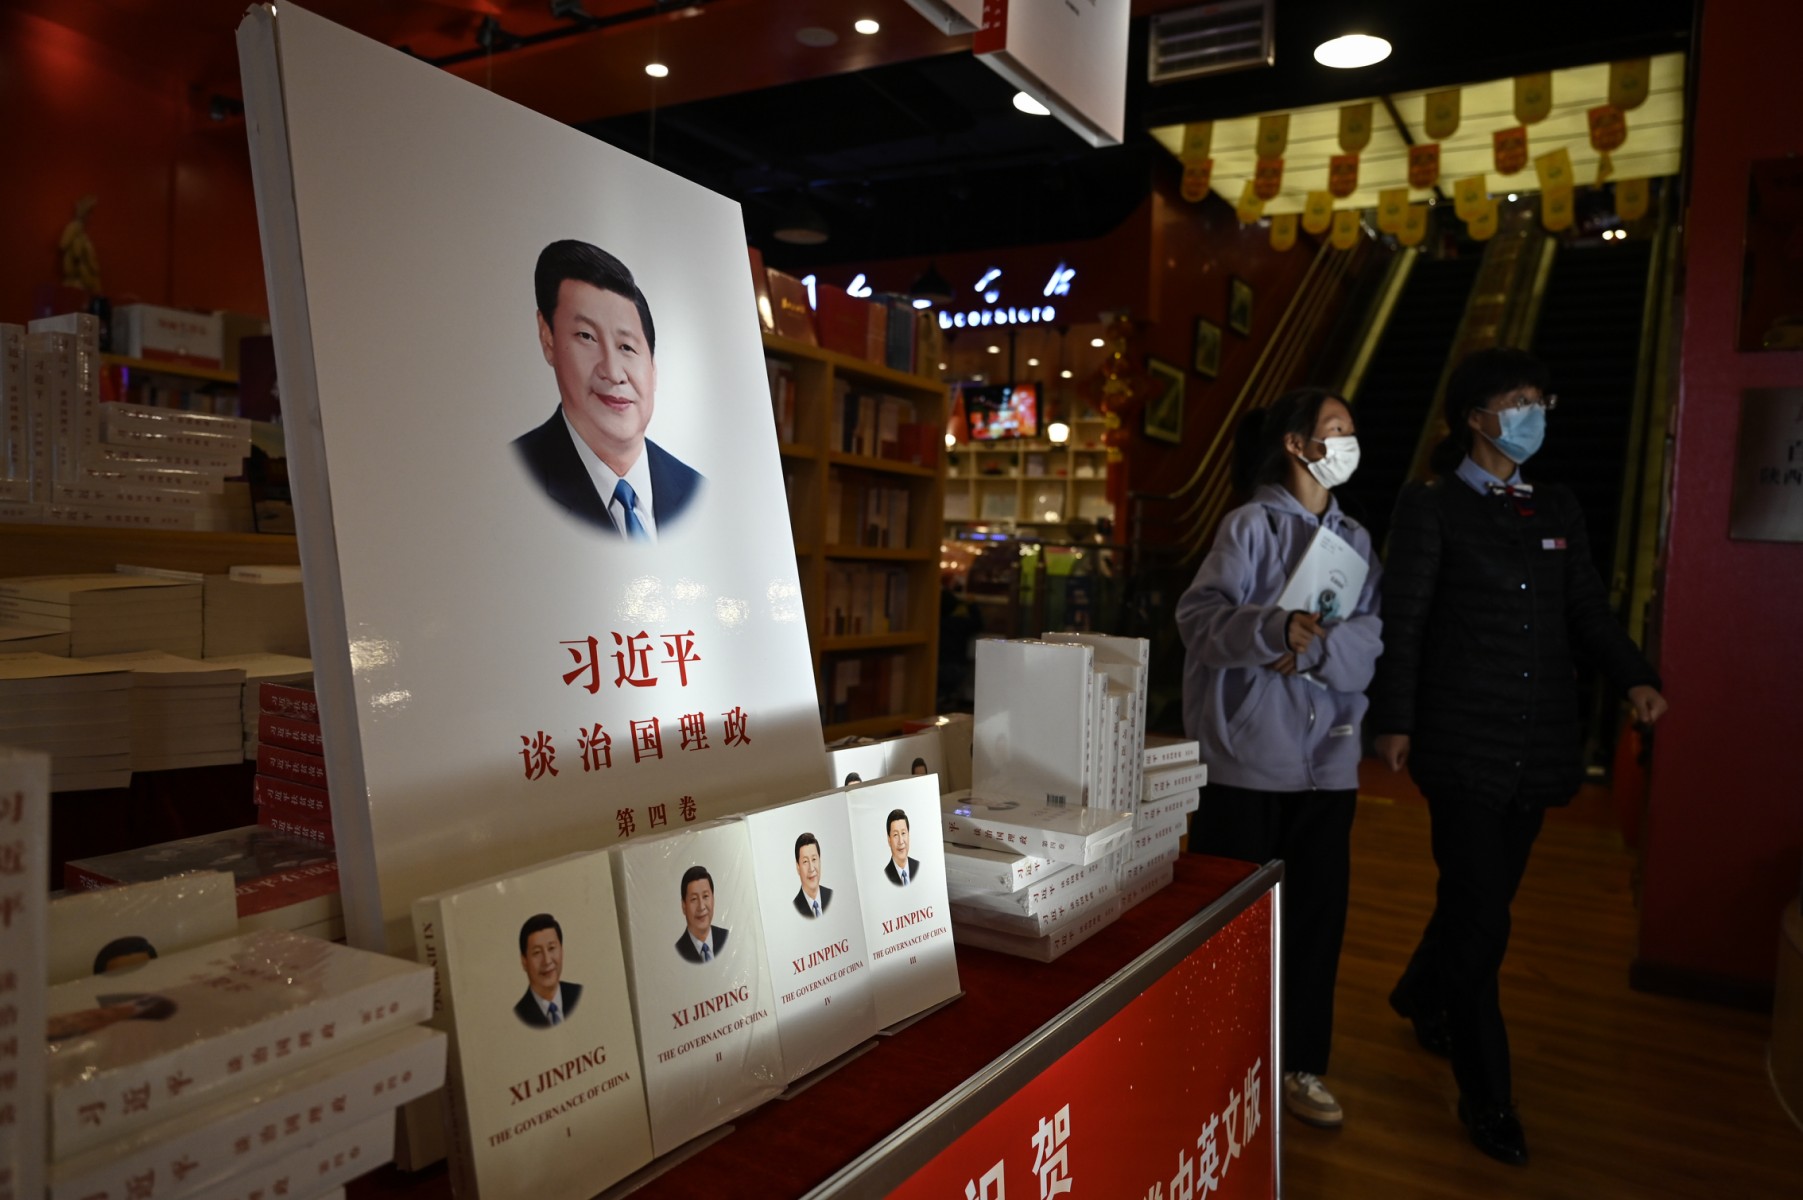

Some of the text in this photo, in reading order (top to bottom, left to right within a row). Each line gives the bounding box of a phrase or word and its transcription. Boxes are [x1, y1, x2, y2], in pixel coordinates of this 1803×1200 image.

[559, 629, 701, 695] 习近平
[518, 706, 752, 781] 谈治国理政
[616, 795, 697, 838] 第四卷
[872, 926, 947, 960] THE GOVERNANCE OF CHINA
[882, 906, 934, 935] XI JINPING
[791, 938, 849, 975] XI JINPING
[909, 956, 917, 965] III
[781, 960, 864, 1005] THE GOVERNANCE OF CHINA
[824, 996, 832, 1006] IV
[671, 985, 749, 1030] XI JINPING
[657, 1009, 768, 1064] THE GOVERNANCE OF CHINA
[715, 1051, 723, 1063] II
[78, 1070, 194, 1126] 习近平
[508, 1045, 606, 1106] XI JINPING
[488, 1071, 630, 1148] THE GOVERNANCE OF CHINA
[1143, 1056, 1262, 1200] 中英文版
